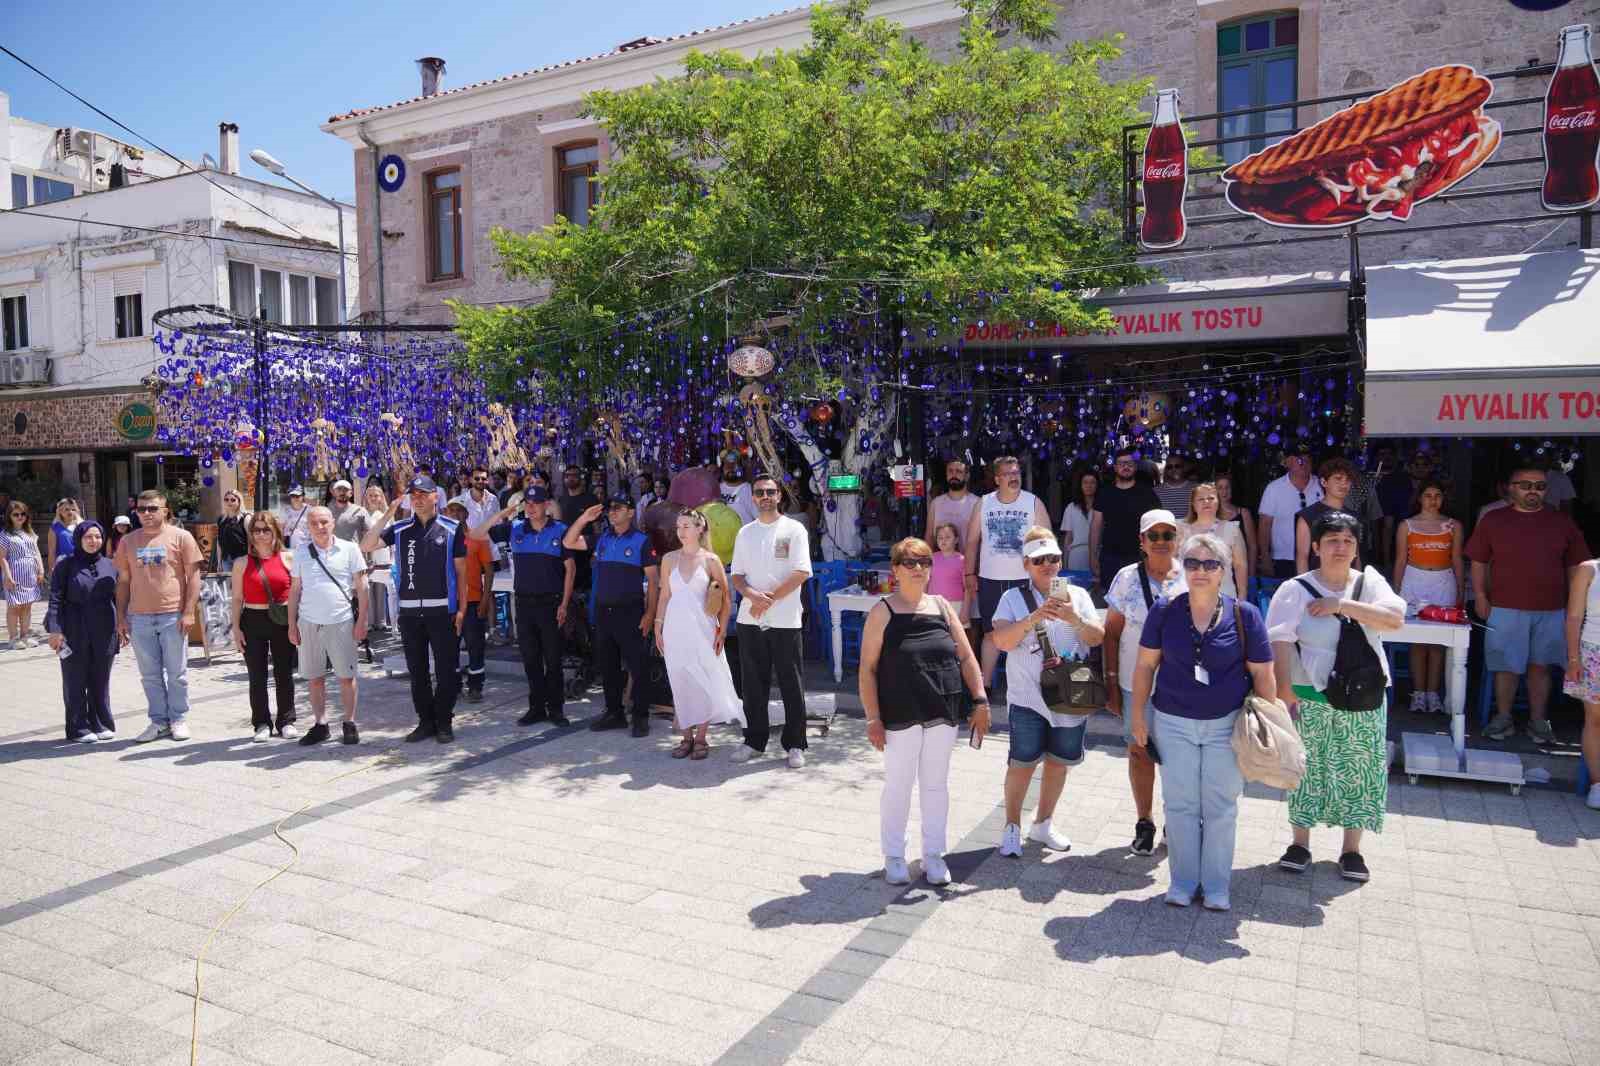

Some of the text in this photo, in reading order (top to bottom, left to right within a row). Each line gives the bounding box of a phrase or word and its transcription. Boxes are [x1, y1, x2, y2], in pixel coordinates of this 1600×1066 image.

[1549, 109, 1596, 130] Coca-Cola
[1146, 161, 1182, 178] Coca-Cola
[1104, 311, 1182, 336] VALIK
[1192, 306, 1263, 331] TOSTU
[1437, 392, 1550, 421] AYVALIK
[407, 539, 416, 590] ZABITA
